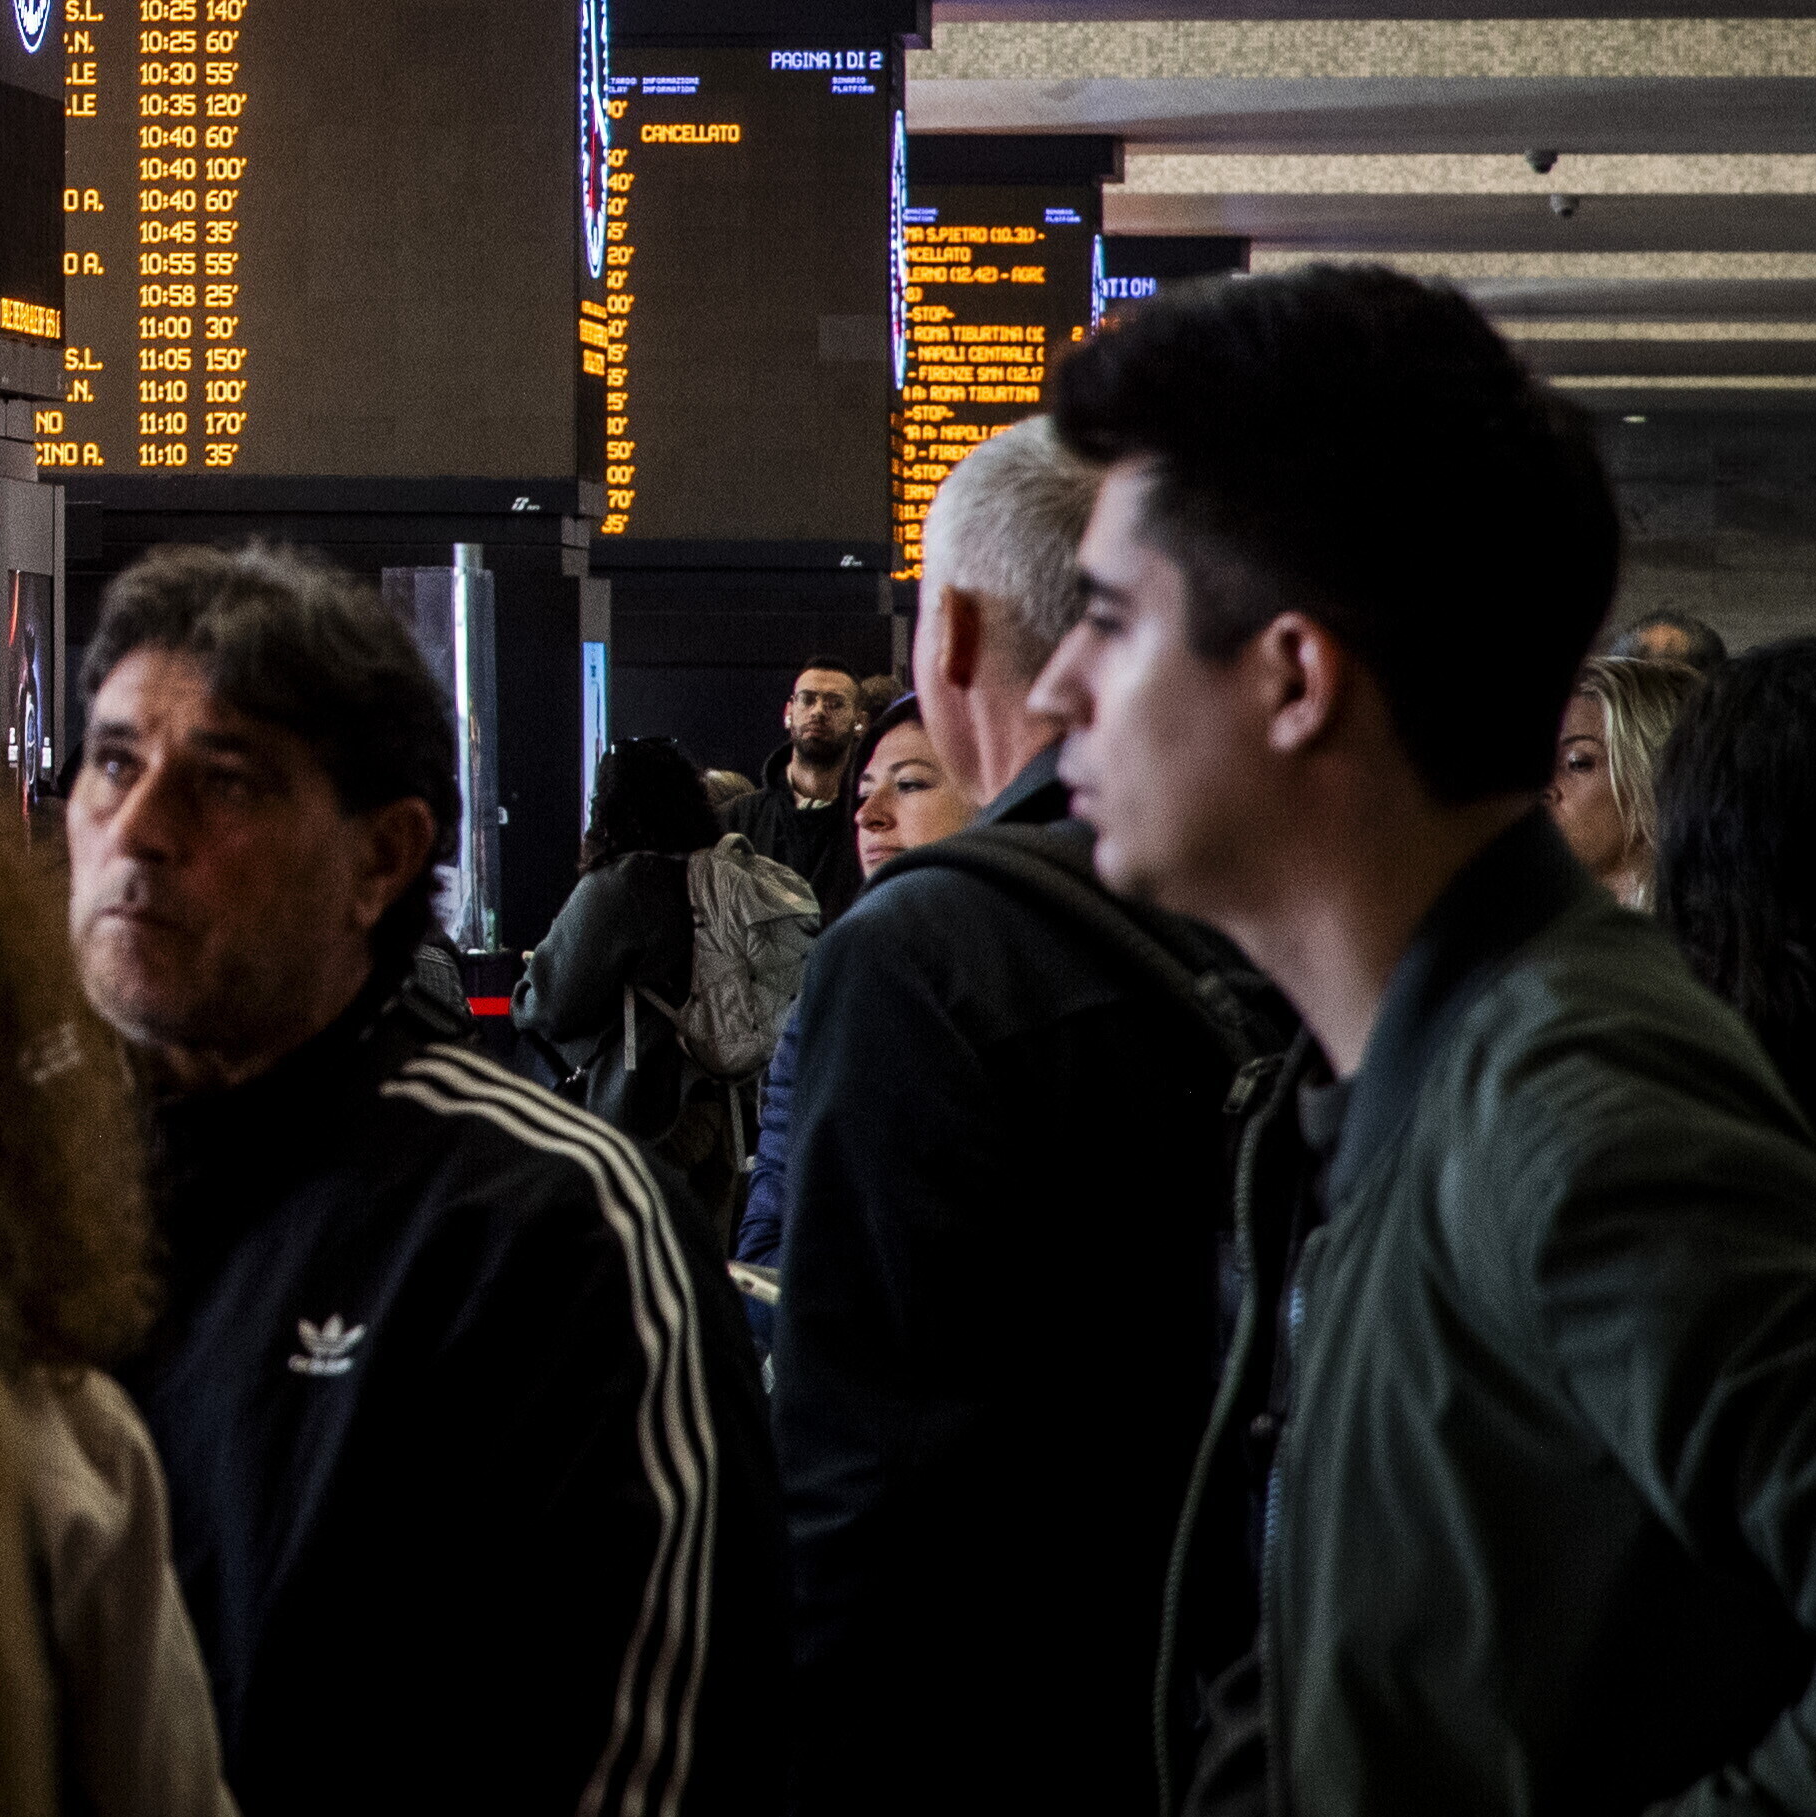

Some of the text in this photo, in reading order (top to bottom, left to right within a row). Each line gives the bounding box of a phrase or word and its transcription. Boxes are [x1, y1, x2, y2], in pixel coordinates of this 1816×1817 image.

[771, 51, 883, 70] PAGINA 1 DI 2
[641, 124, 740, 143] CANCELLATO
[139, 379, 247, 403] 11:10 100'
[139, 443, 239, 466] 11:10 35'
